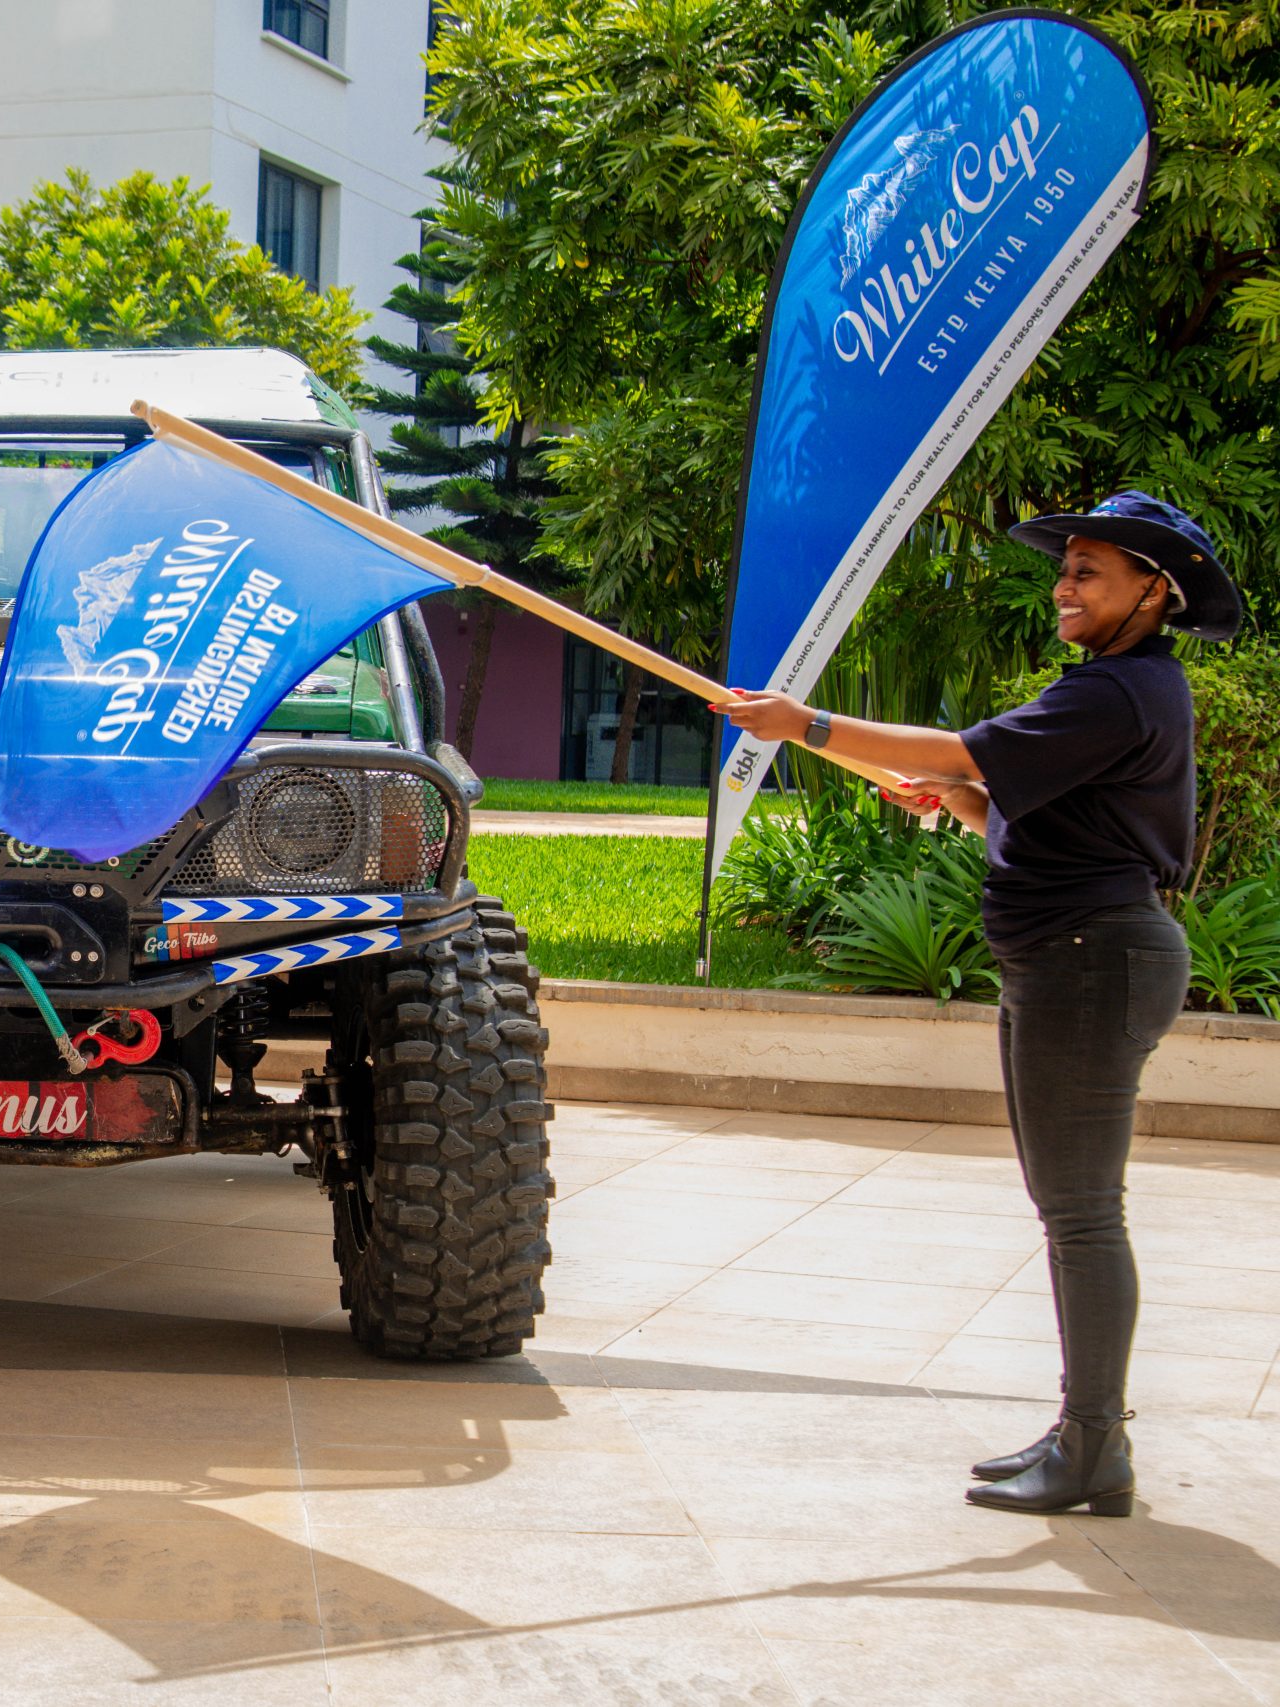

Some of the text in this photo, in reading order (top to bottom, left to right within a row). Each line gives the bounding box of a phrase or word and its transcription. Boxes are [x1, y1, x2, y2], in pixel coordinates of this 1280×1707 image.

[833, 105, 1039, 363] White Cap
[918, 167, 1076, 374] ESTD KENYA 1950
[786, 180, 1141, 686] ALCOHOL CONSUMPTION IS HARMFUL TO YOUR HEALTH. NOT FOR SALE TO PERSONS UNDER THE AGE OF 18 YEARS.
[144, 932, 218, 953] Geco Tribe
